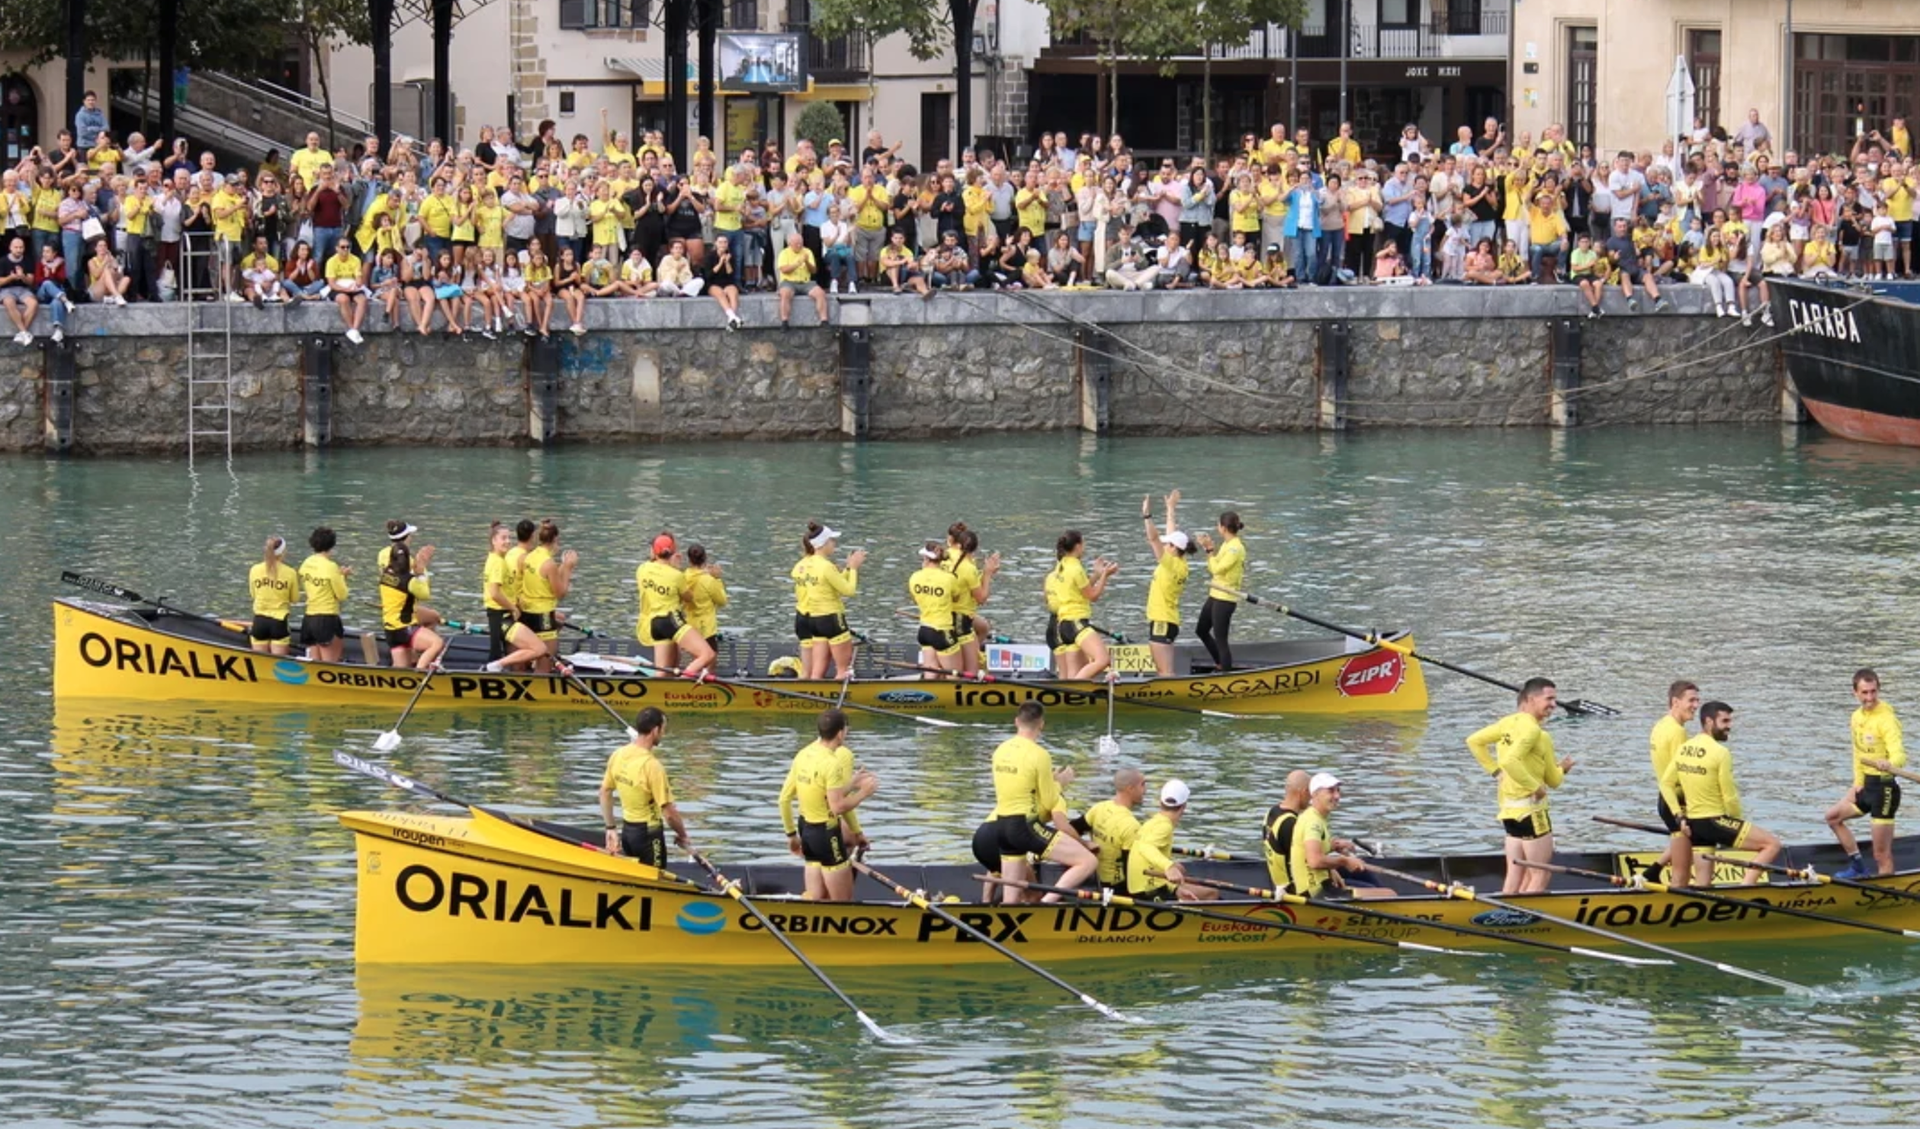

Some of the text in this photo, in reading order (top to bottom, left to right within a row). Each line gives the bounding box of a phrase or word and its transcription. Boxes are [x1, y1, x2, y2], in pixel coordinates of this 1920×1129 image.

[1789, 298, 1861, 343] CARABA
[914, 583, 944, 597] ORIO
[79, 632, 259, 683] ORIALKI
[1108, 647, 1141, 657] DEGA
[316, 670, 434, 692] ORBINOX
[450, 677, 537, 702] PBX
[548, 677, 648, 699] INDO
[1188, 669, 1320, 699] SAGARDI
[1125, 691, 1175, 700] URMA
[395, 864, 653, 931] ORIALKI
[1778, 895, 1837, 909] URMA
[738, 913, 899, 936] ORBINOX
[1053, 907, 1185, 932] INDO
[1483, 911, 1533, 925] Ford
[1575, 898, 1769, 928] iraupen
[916, 912, 1034, 943] PBX
[1197, 933, 1268, 943] LowCost
